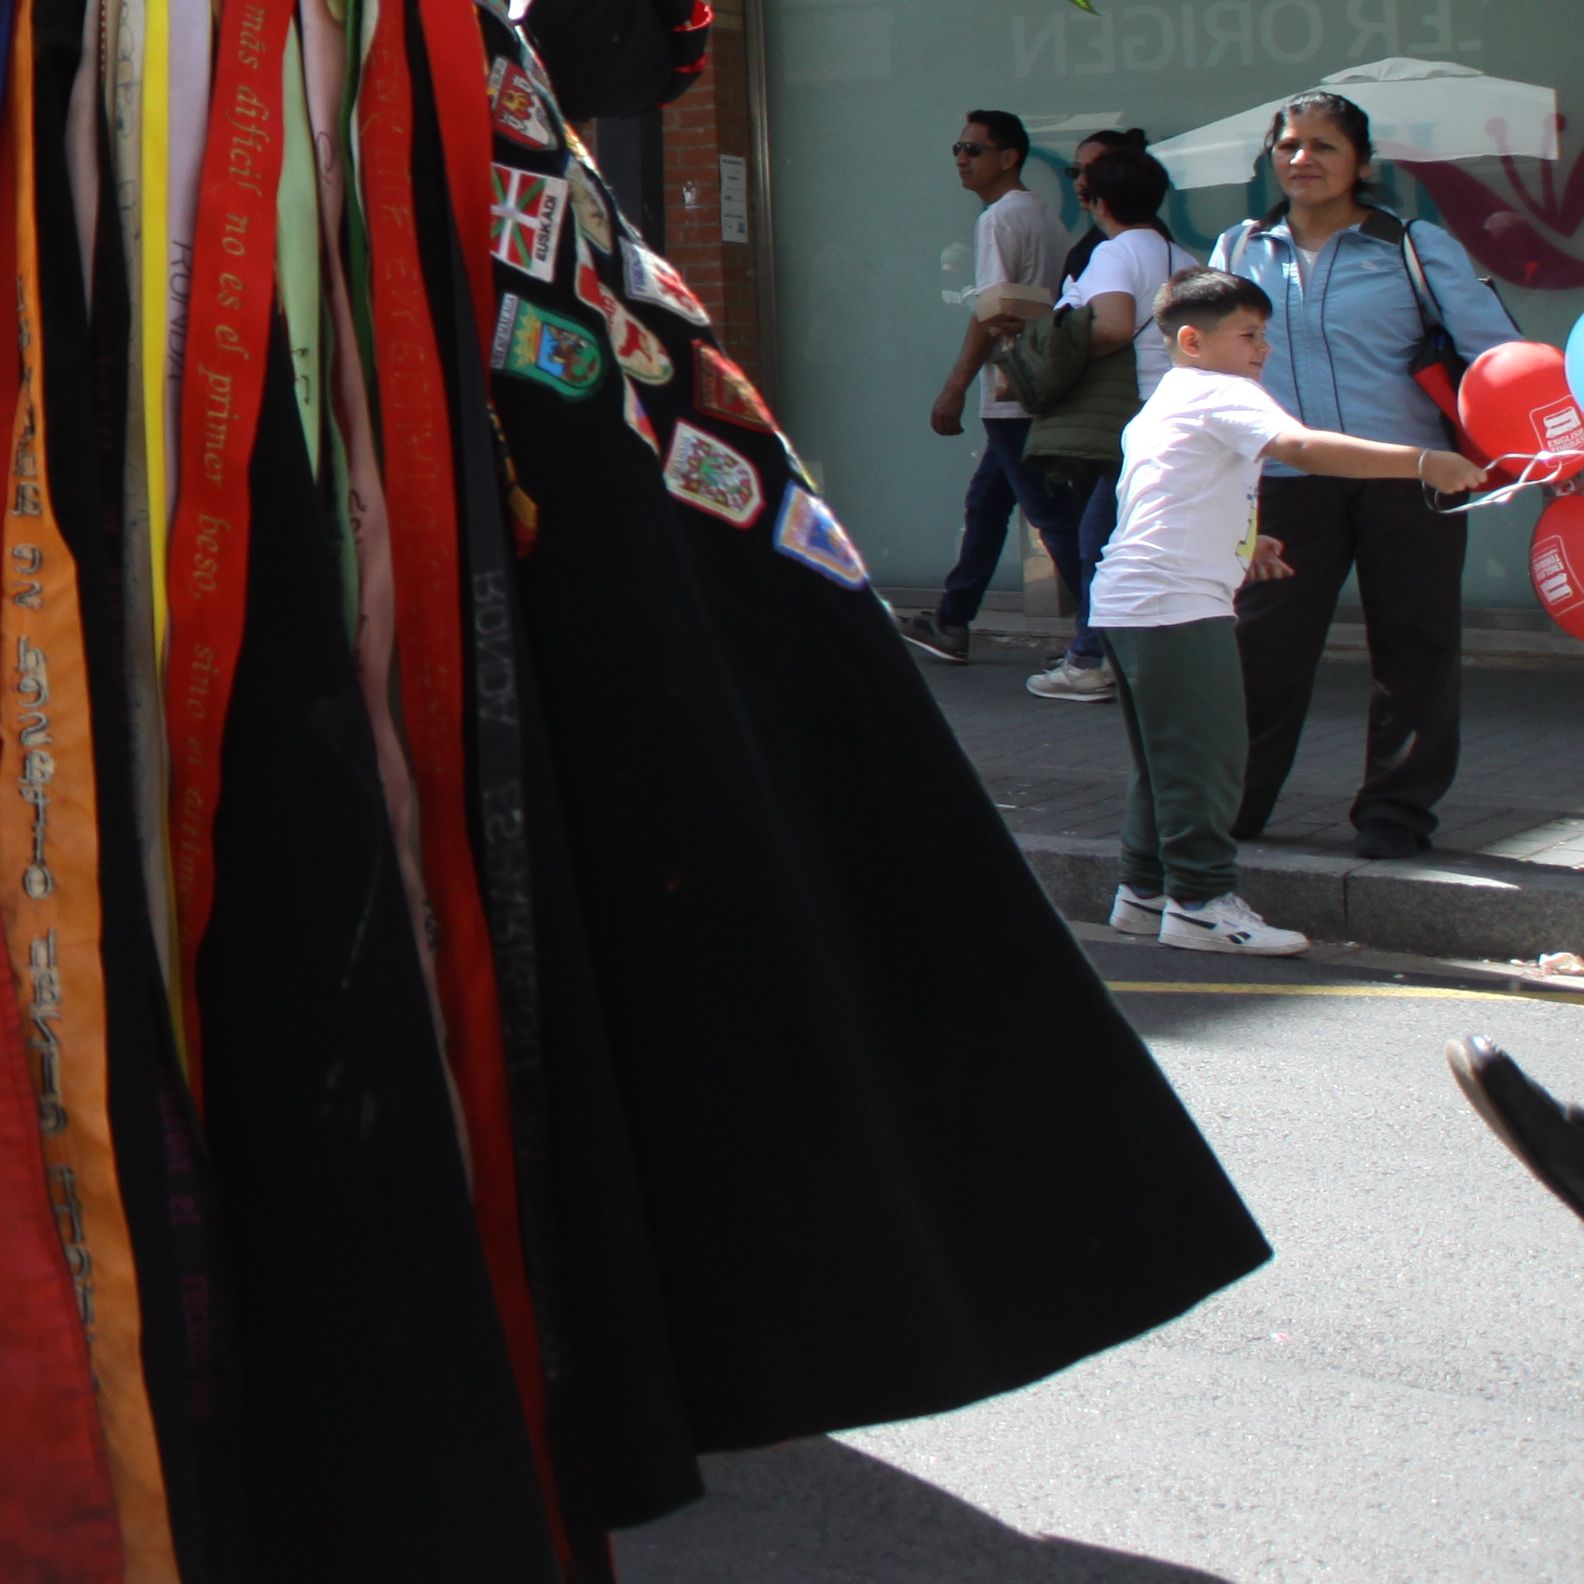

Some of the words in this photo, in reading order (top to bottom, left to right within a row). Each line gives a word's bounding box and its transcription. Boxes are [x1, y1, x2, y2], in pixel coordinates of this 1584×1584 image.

[235, 3, 268, 71] más
[221, 213, 252, 257] no
[535, 194, 558, 263] EUSKADI
[215, 273, 246, 309] es
[214, 323, 250, 359] el
[197, 363, 238, 487] primer
